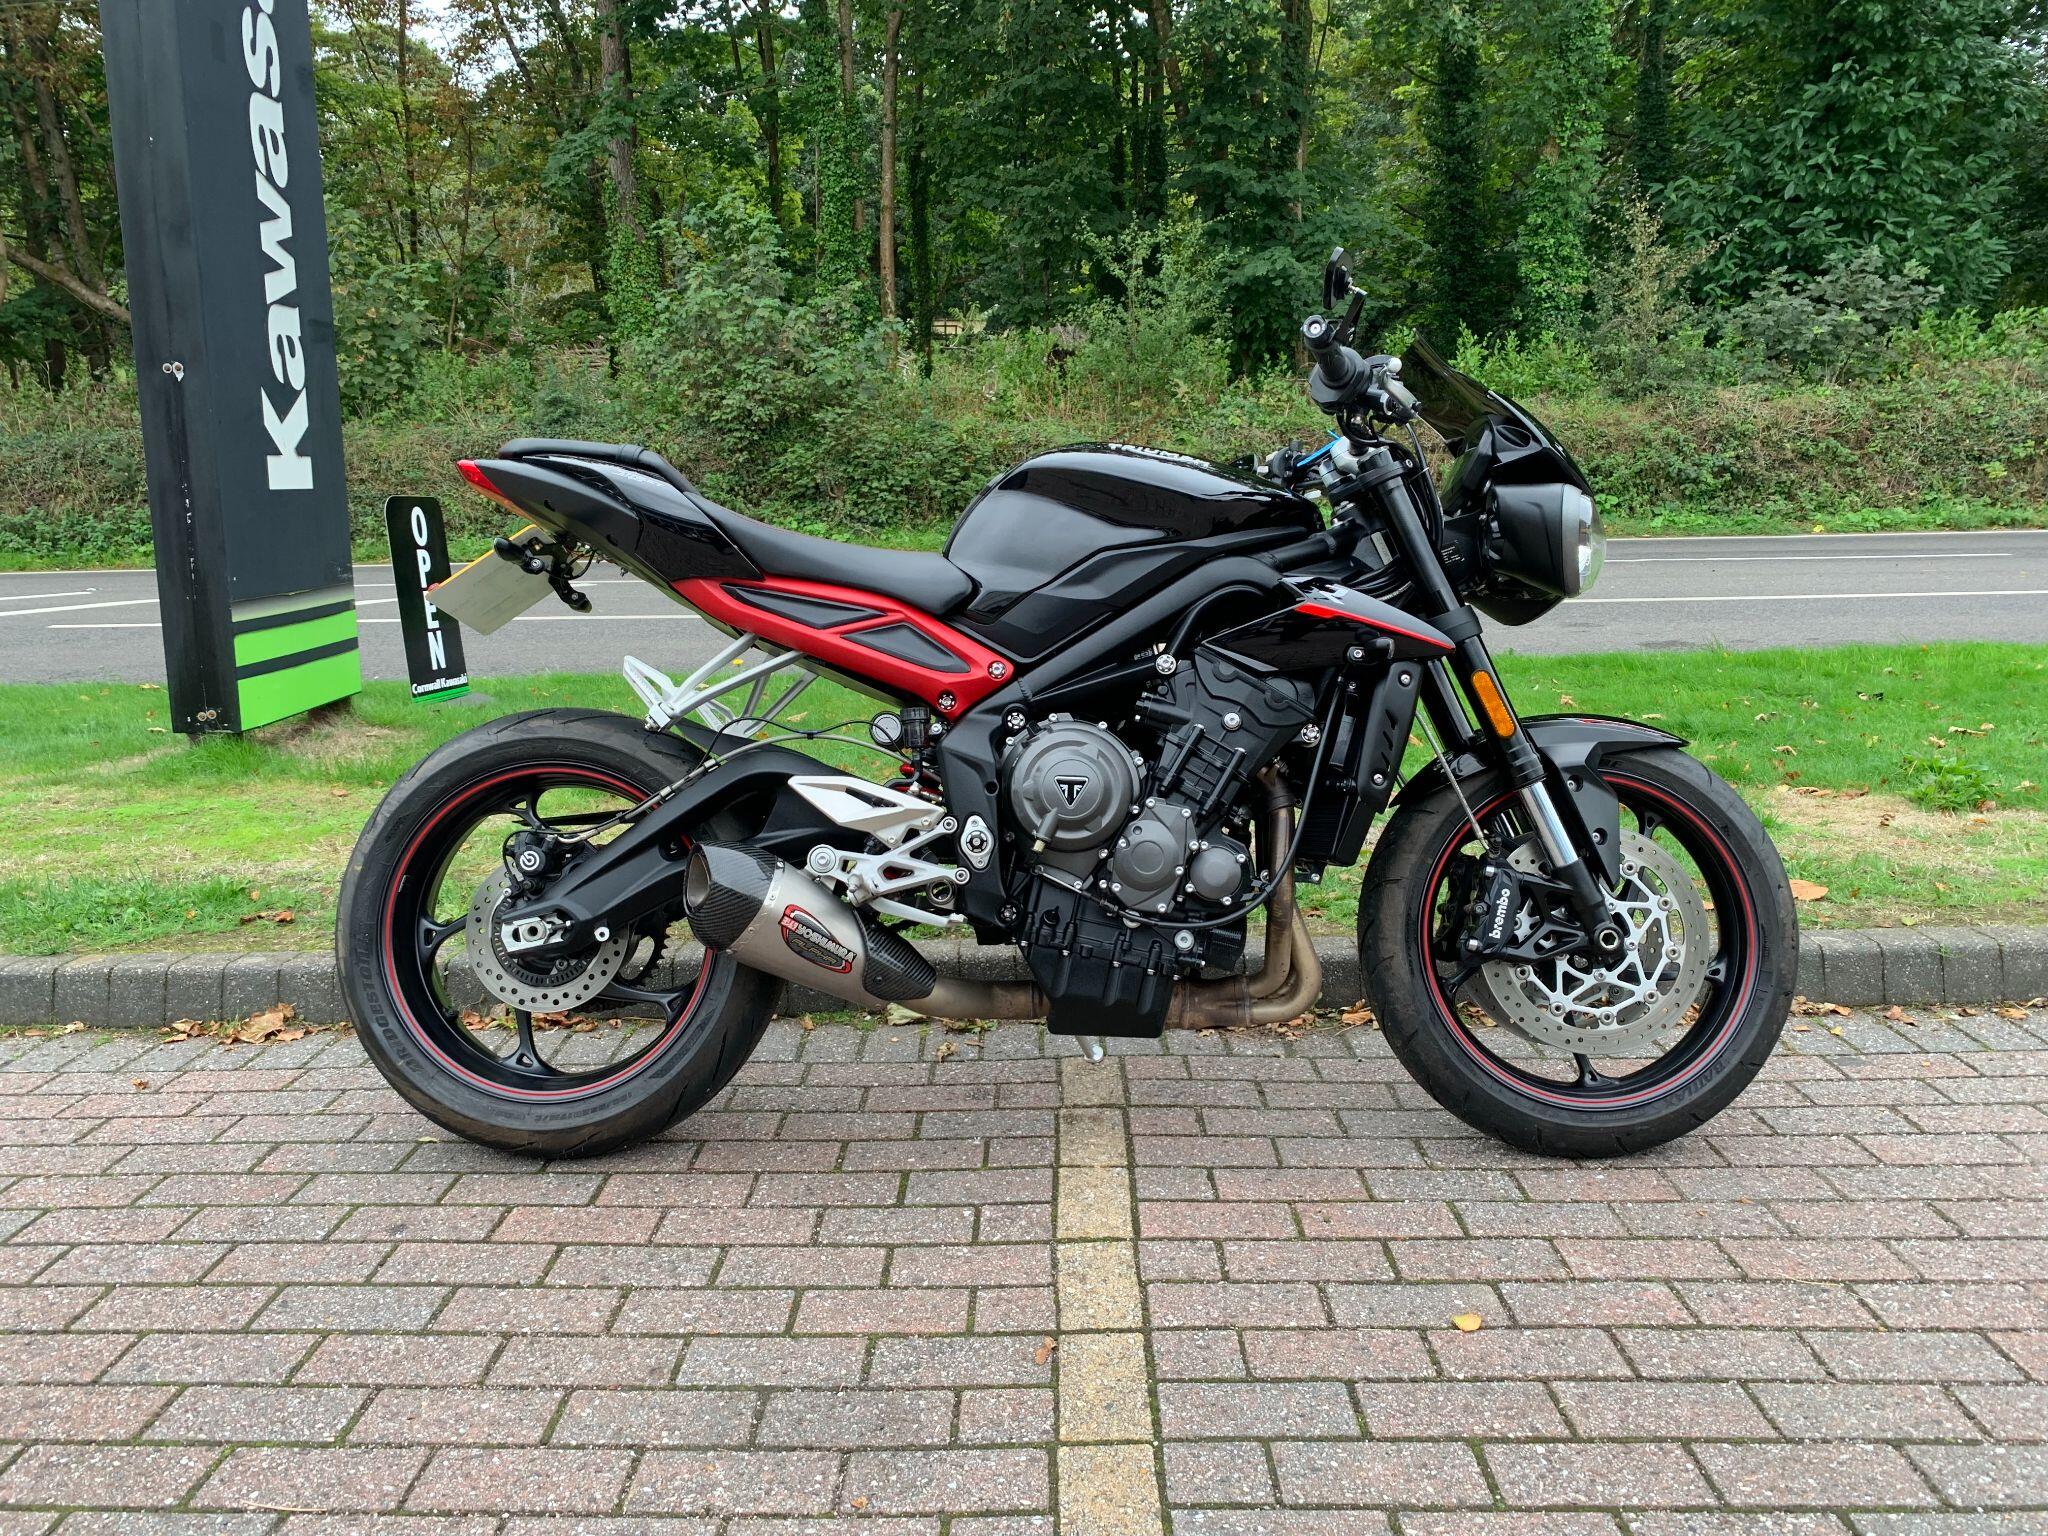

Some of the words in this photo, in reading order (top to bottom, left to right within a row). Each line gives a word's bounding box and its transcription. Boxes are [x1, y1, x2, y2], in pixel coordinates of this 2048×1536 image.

[242, 0, 314, 490] Kawas
[412, 678, 441, 694] Cornwall
[440, 673, 468, 688] Kawasaki
[1488, 888, 1511, 939] brembo
[796, 923, 854, 963] YOSHIMURA
